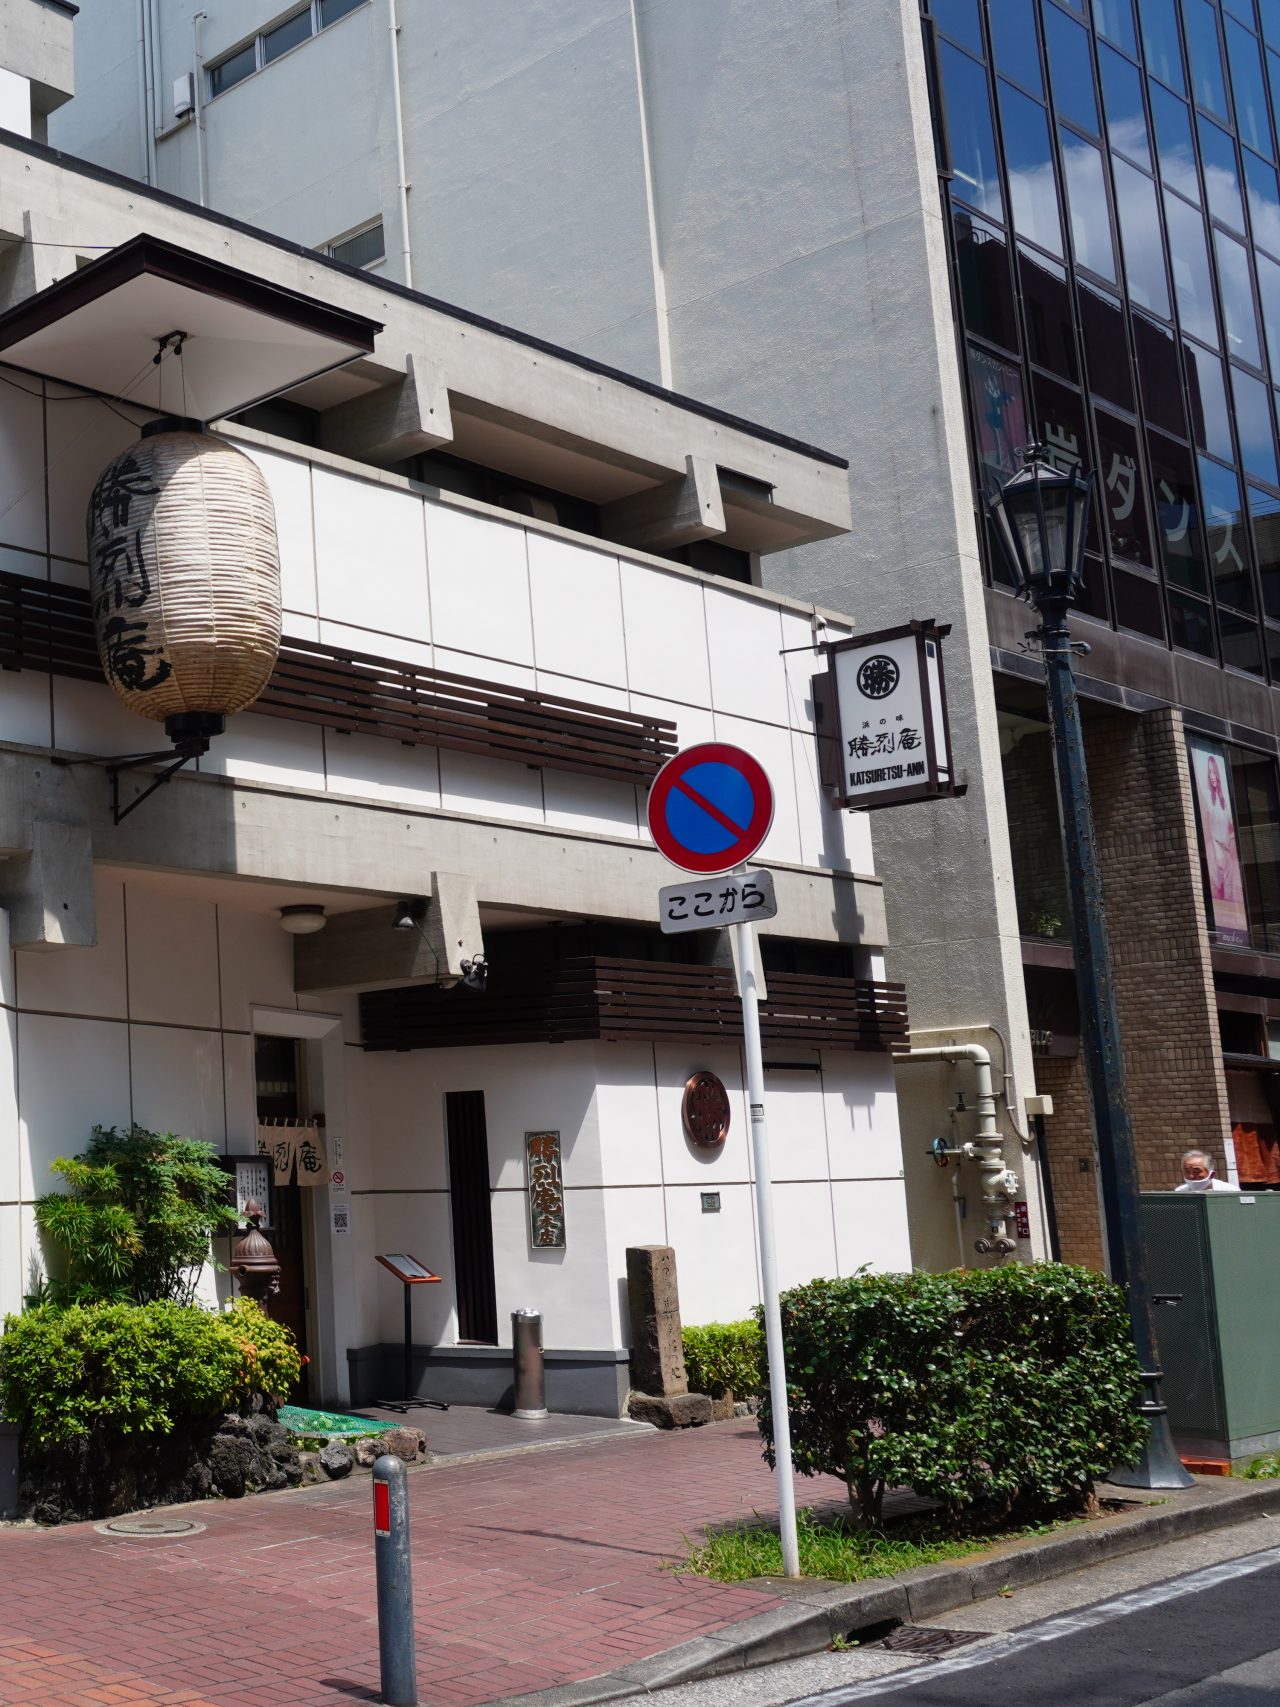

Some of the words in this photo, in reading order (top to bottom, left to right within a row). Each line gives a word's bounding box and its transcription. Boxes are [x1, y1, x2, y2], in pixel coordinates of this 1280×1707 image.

[862, 714, 904, 729] 浜の味
[847, 728, 922, 759] 勝烈庵
[849, 761, 925, 787] KATSURETSU-ANN
[668, 883, 766, 920] ここから
